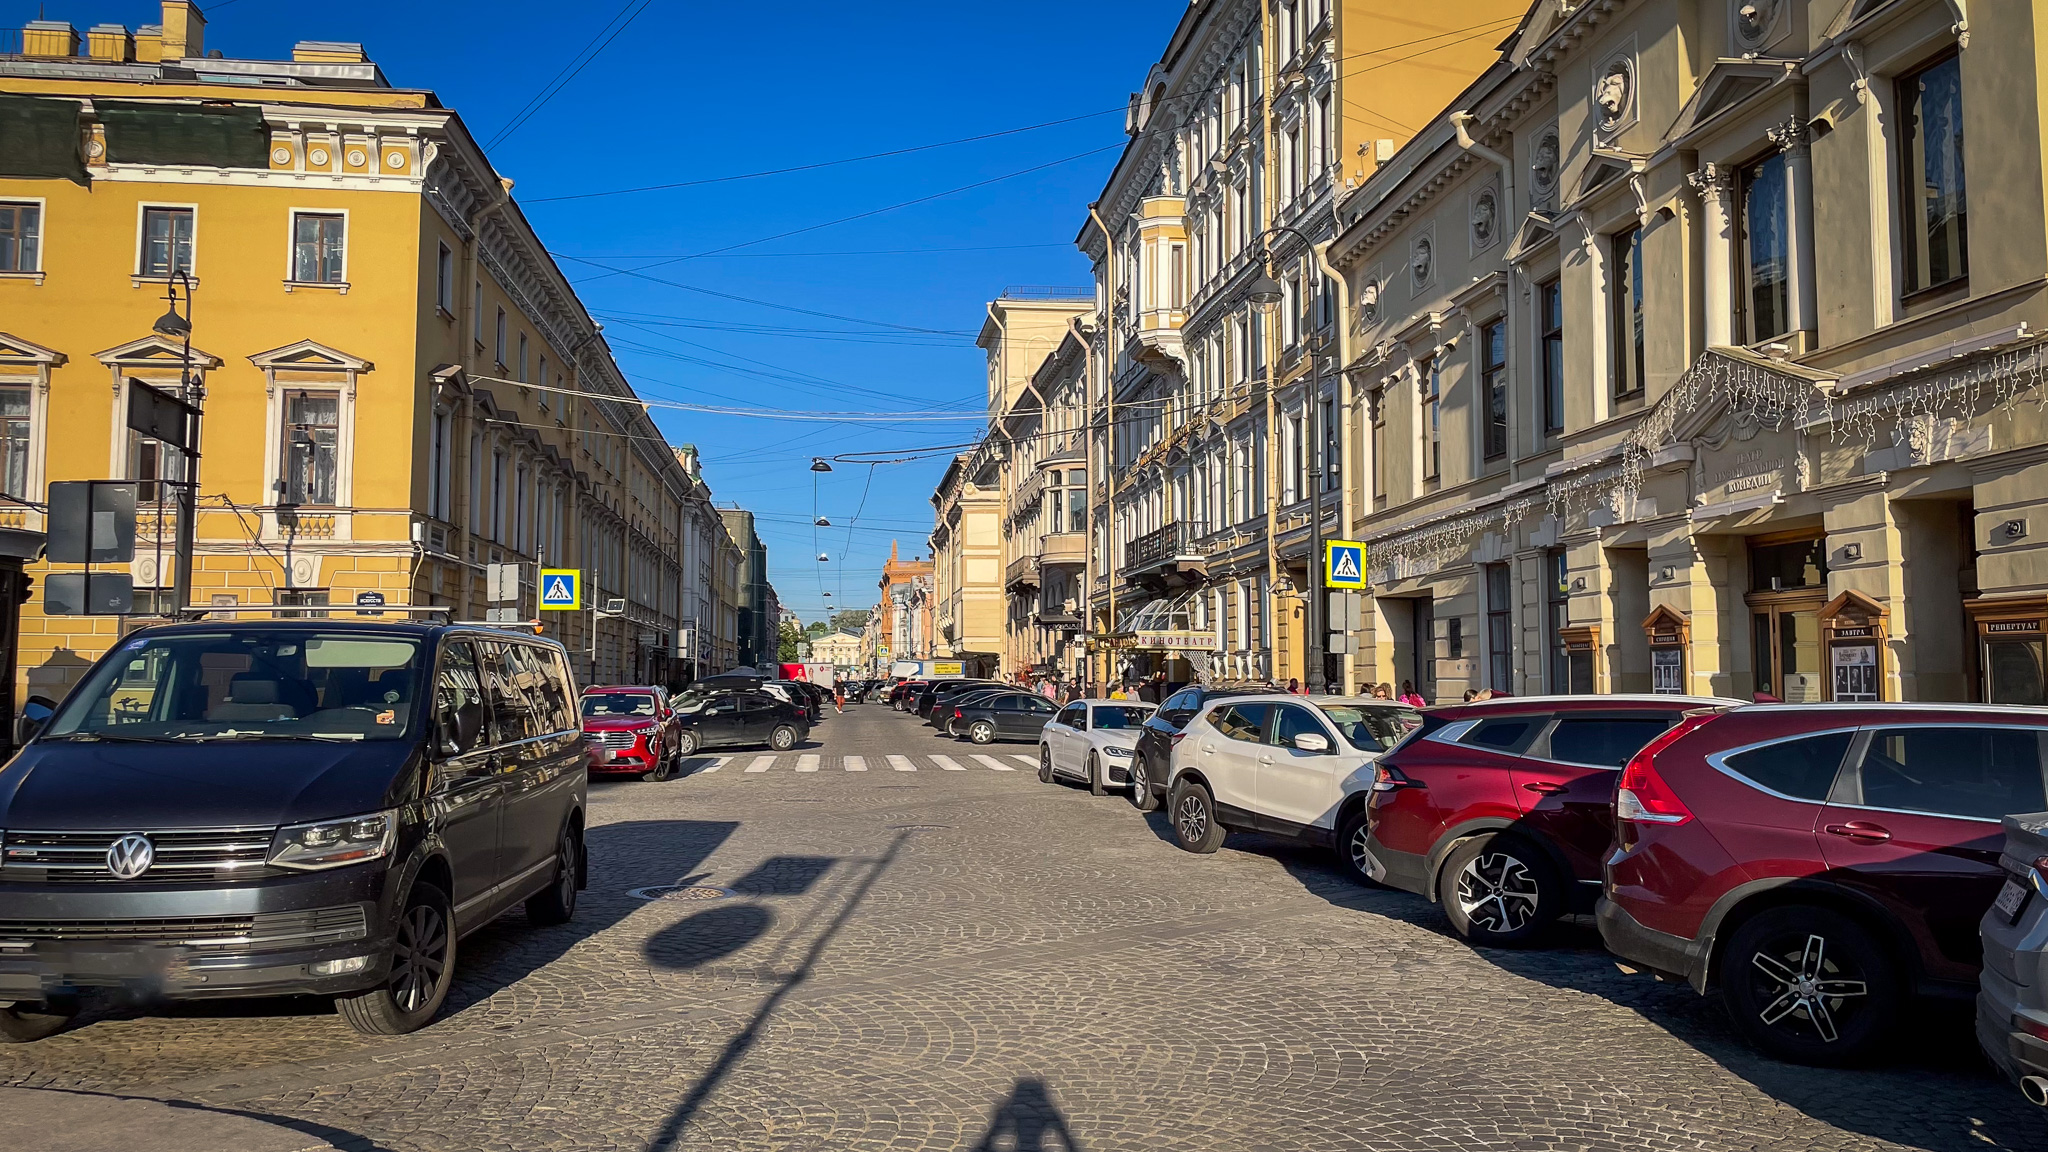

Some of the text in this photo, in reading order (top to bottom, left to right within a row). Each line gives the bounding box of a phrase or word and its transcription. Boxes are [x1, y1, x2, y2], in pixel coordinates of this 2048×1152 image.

[1727, 473, 1772, 493] КОМЕДИИ
[1990, 622, 2038, 631] РЕПЕРТУАР
[1841, 628, 1865, 637] ЗАВТРА
[1141, 636, 1213, 646] КИНОТЕАТР
